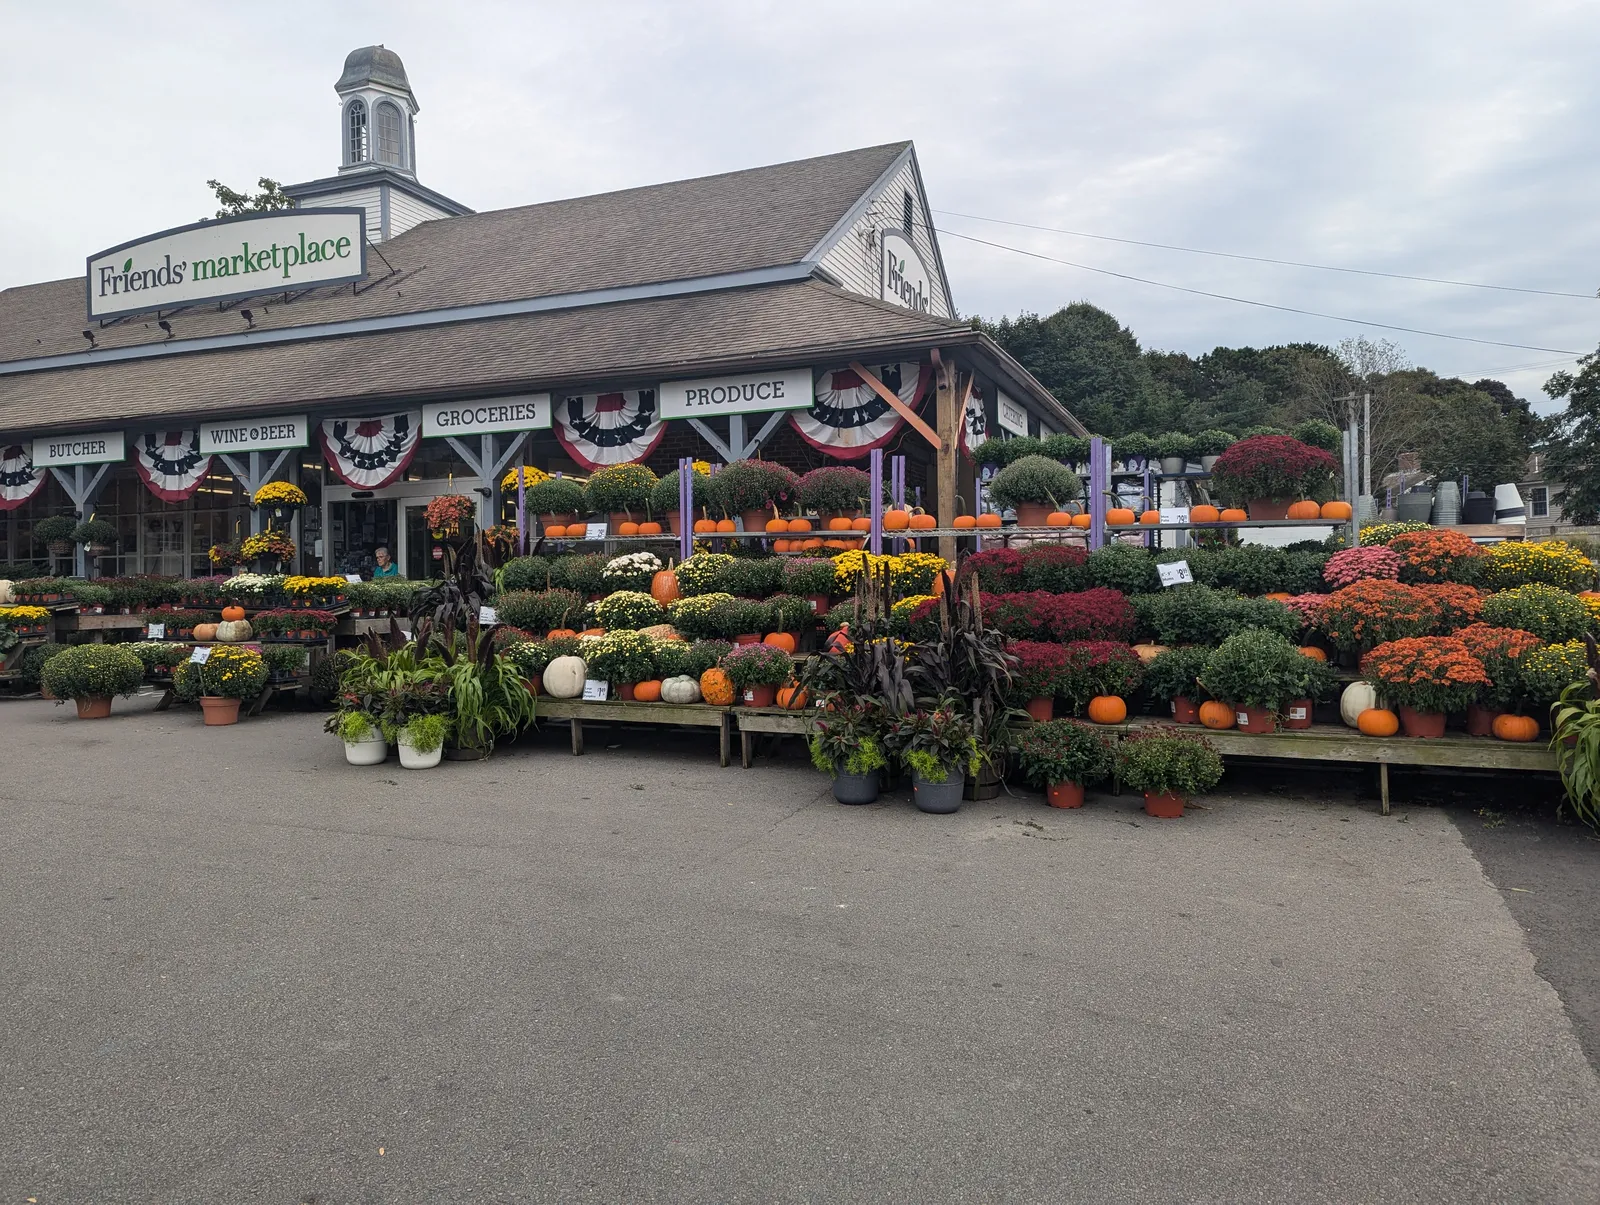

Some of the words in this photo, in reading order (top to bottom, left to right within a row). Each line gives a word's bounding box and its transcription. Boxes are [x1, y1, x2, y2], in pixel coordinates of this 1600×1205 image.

[98, 253, 187, 297] Friends'
[191, 232, 351, 280] marketplace
[685, 380, 785, 407] PRODUCE
[436, 403, 536, 428] GROCERIES
[210, 427, 248, 444] WINE
[249, 428, 259, 441] &
[260, 423, 296, 440] BEER
[49, 440, 106, 458] BUTCHER
